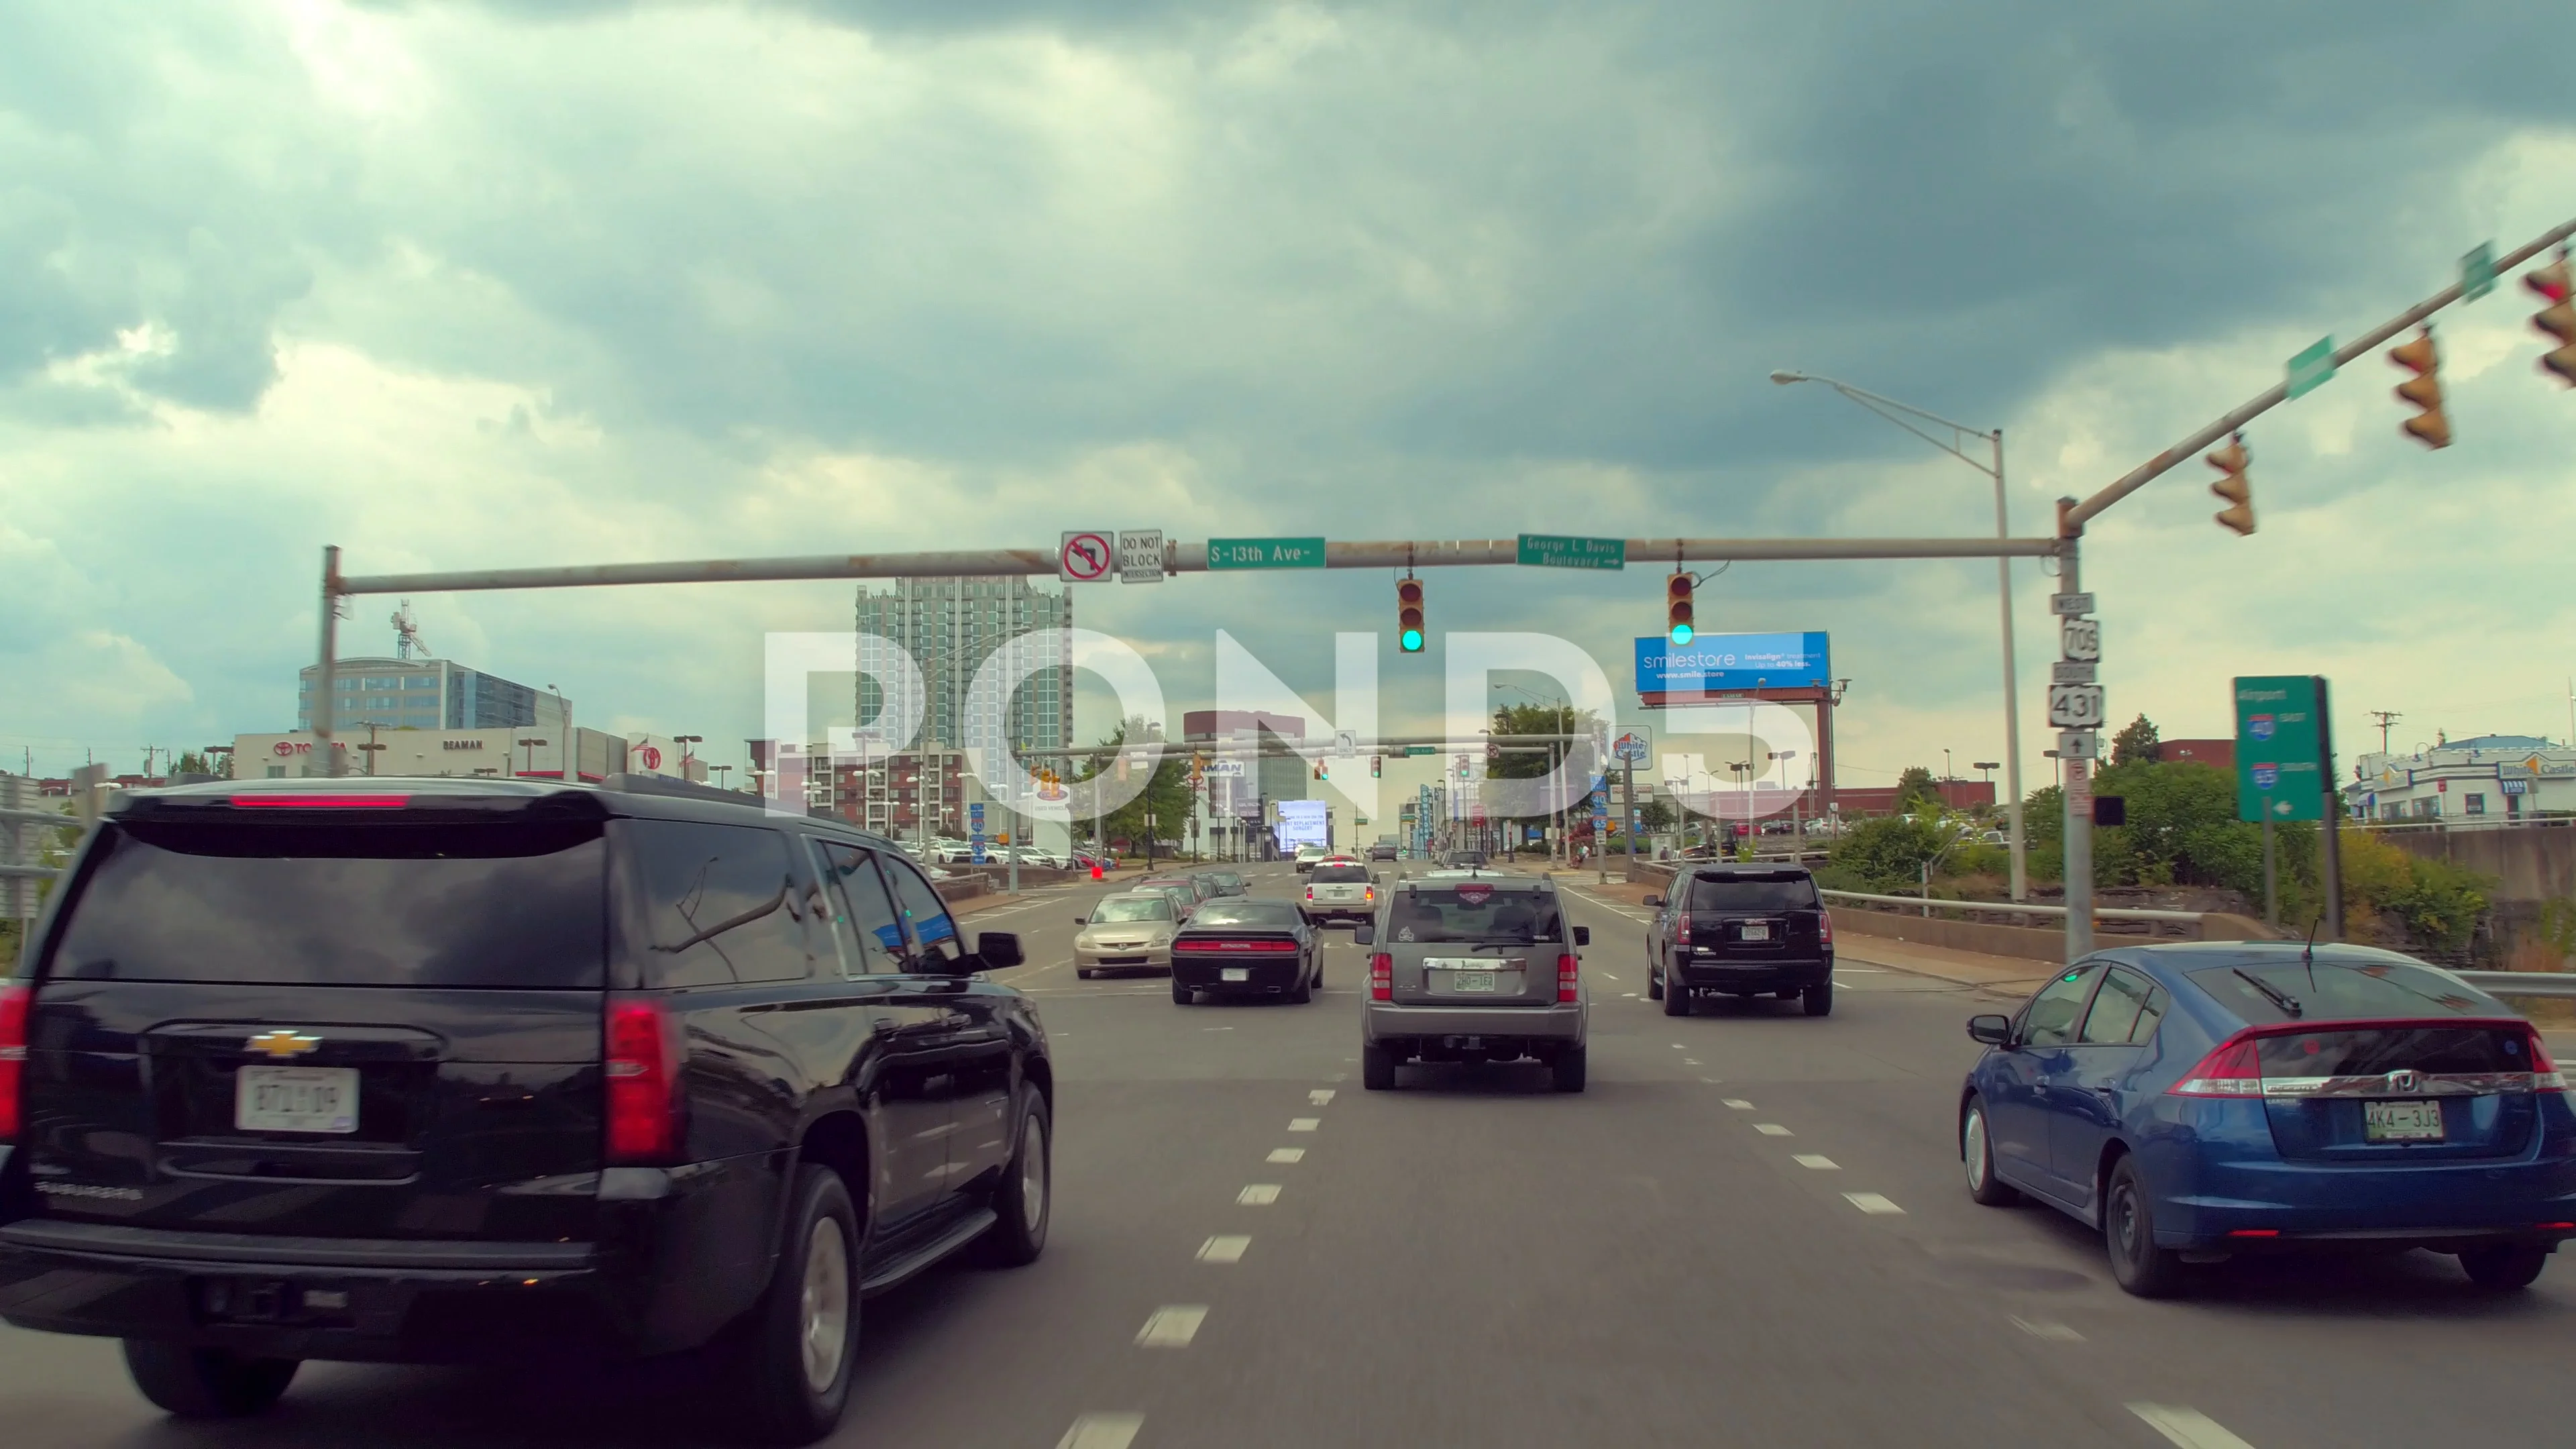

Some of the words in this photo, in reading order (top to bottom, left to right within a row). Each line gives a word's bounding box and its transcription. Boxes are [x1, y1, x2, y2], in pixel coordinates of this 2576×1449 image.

[1123, 537, 1136, 550] DO
[1140, 536, 1159, 549] NOT
[1527, 537, 1564, 553] George
[1586, 539, 1615, 553] Davis
[1123, 553, 1161, 567] BLOCK
[1210, 546, 1263, 562] S-13th
[1543, 552, 1599, 568] Boulevard
[1644, 651, 1735, 669] smilestore
[1656, 669, 1724, 680] www.smile.store
[2053, 694, 2099, 718] 431
[443, 740, 484, 750] BEAMAN
[2502, 765, 2534, 775] White
[2540, 763, 2576, 774] Castle
[1594, 796, 1605, 804] 40
[973, 822, 983, 830] 40
[1595, 820, 1606, 828] 65
[2367, 1110, 2439, 1128] 4K4-3J3
